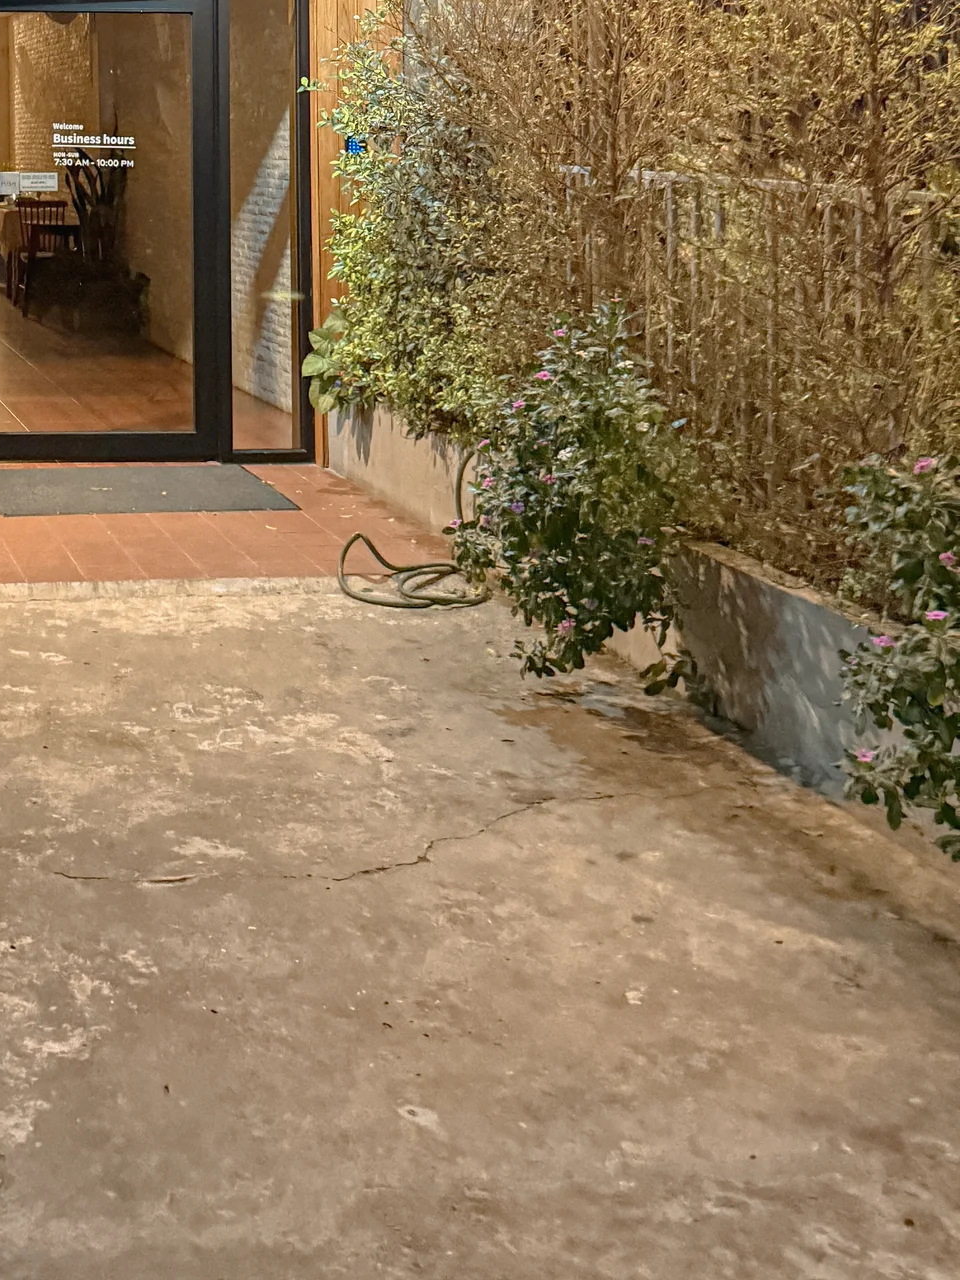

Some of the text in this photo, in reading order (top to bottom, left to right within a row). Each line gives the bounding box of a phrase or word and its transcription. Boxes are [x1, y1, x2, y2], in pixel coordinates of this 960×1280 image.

[52, 122, 84, 131] Welcome
[53, 133, 135, 145] Business hours
[54, 158, 73, 166] 7:30
[74, 159, 89, 167] AM
[97, 159, 119, 167] 10:00
[121, 160, 134, 168] PM
